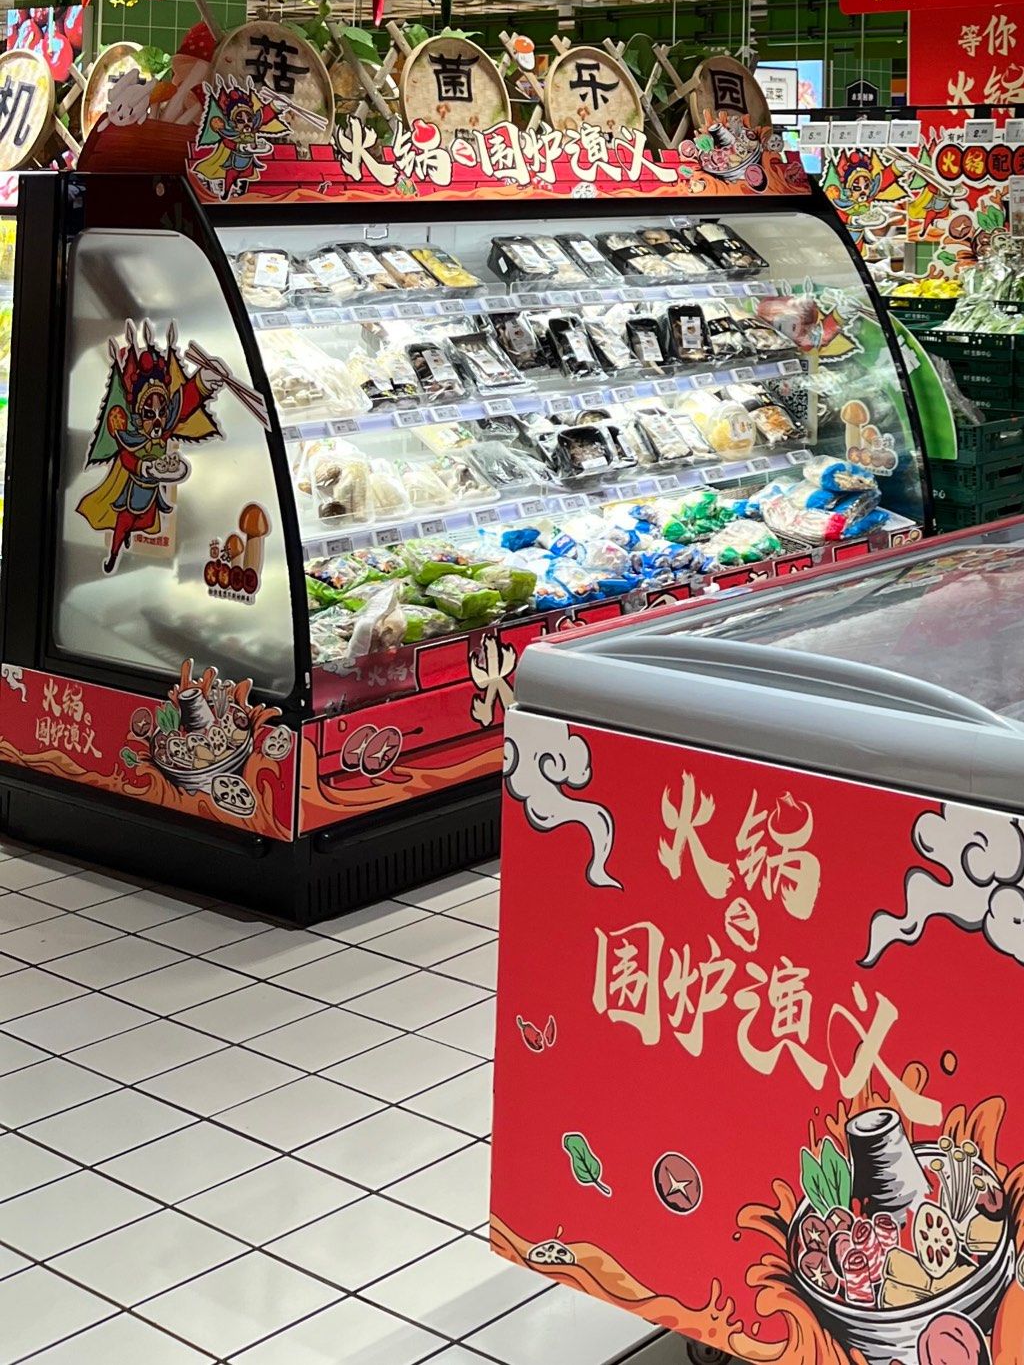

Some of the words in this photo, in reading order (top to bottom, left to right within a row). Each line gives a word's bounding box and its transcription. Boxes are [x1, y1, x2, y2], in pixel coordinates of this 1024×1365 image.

[246, 35, 310, 94] 菇
[429, 53, 479, 103] 菌
[570, 63, 619, 111] 乐
[709, 69, 746, 114] 园
[958, 14, 1017, 57] 等你
[591, 920, 944, 1127] 围炉演义
